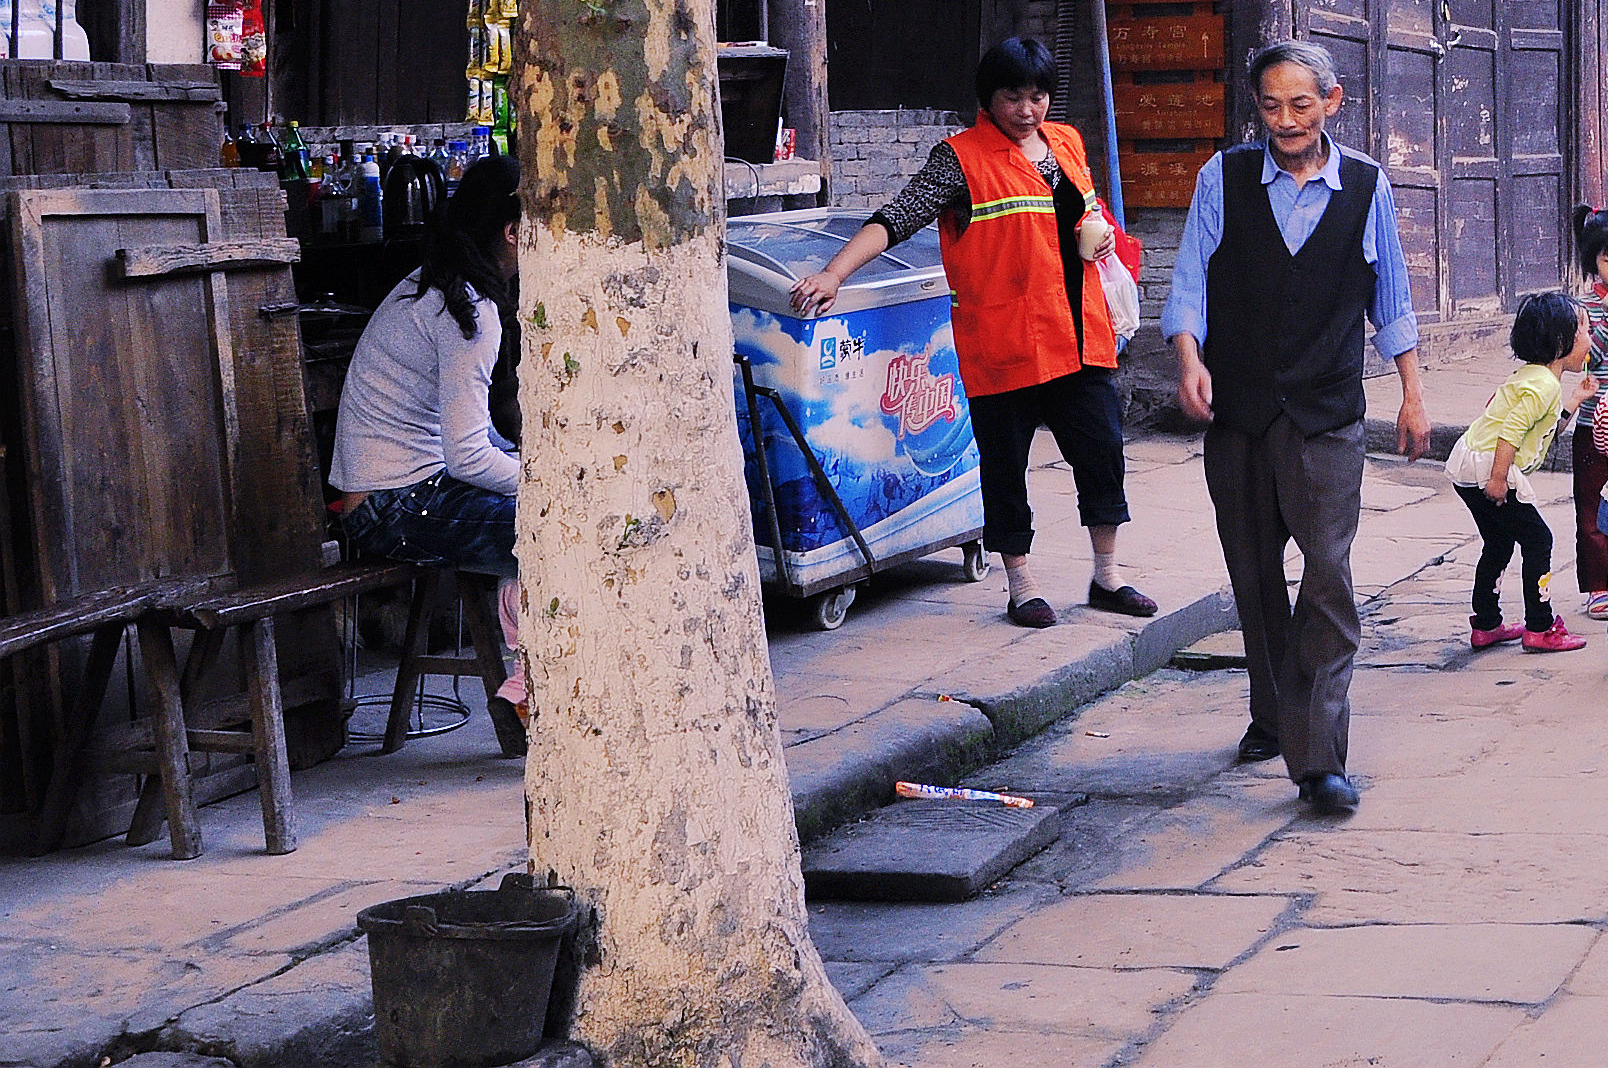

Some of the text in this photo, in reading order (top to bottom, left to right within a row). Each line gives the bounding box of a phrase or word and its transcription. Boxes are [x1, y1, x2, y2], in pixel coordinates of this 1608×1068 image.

[1113, 25, 1187, 40] 万寿宫
[839, 335, 866, 363] 蒙牛
